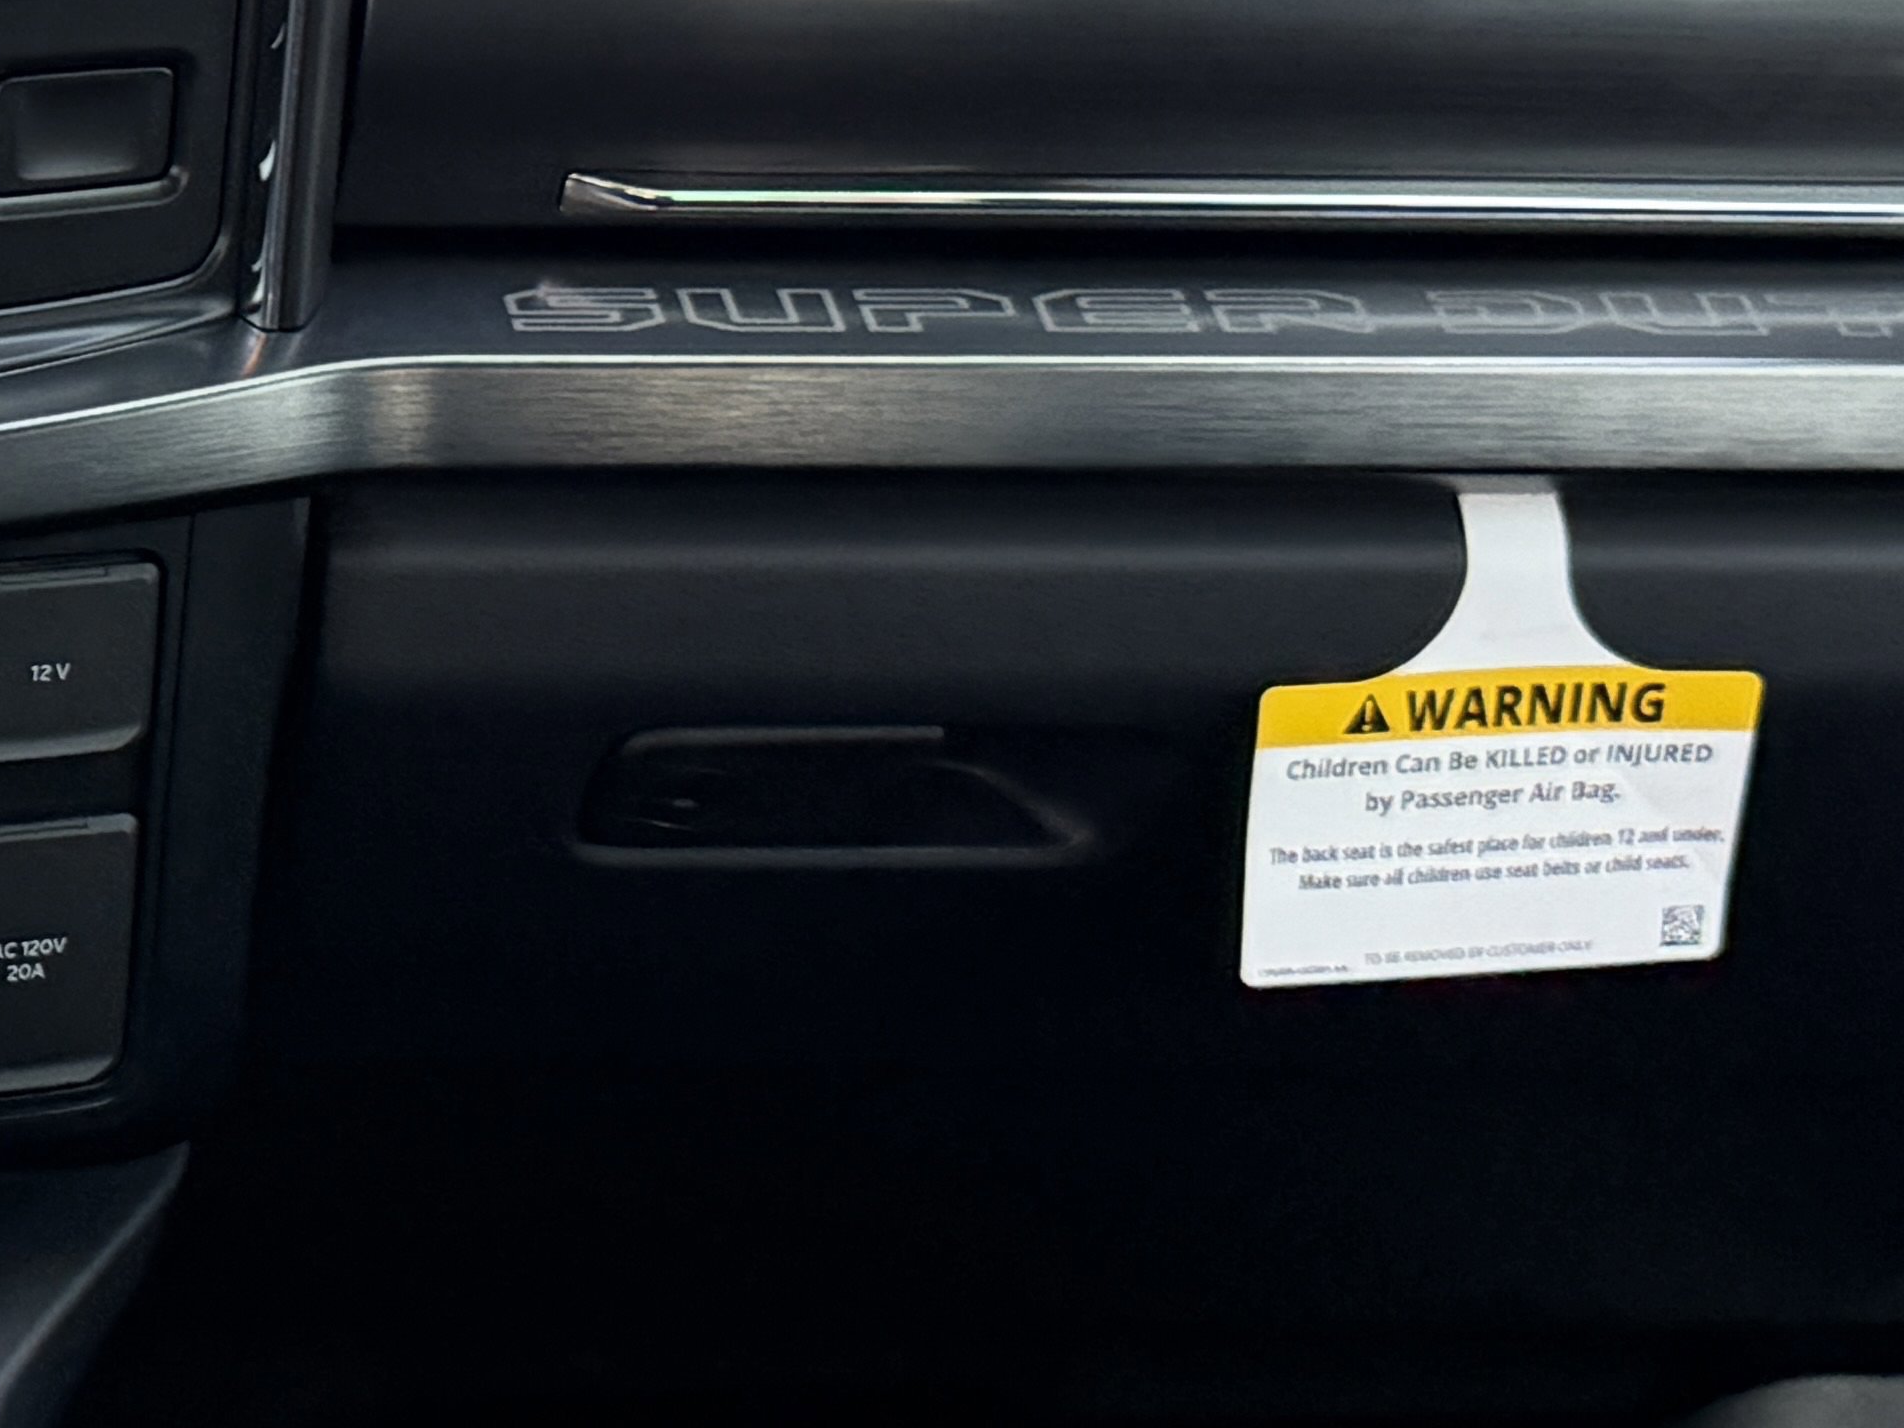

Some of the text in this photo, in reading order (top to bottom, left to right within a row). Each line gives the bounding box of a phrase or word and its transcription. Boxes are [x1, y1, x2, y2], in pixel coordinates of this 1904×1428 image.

[503, 285, 1376, 335] SUPER
[1406, 681, 1667, 733] WARNING
[1286, 741, 1714, 781] Children Can Be KILLED or INJURED
[1364, 780, 1623, 818] by Passenger Air Bag.
[1269, 847, 1299, 866] The
[1302, 844, 1340, 864] back
[1297, 873, 1341, 891] Make
[20, 936, 68, 958] 120V
[6, 963, 46, 982] 20A
